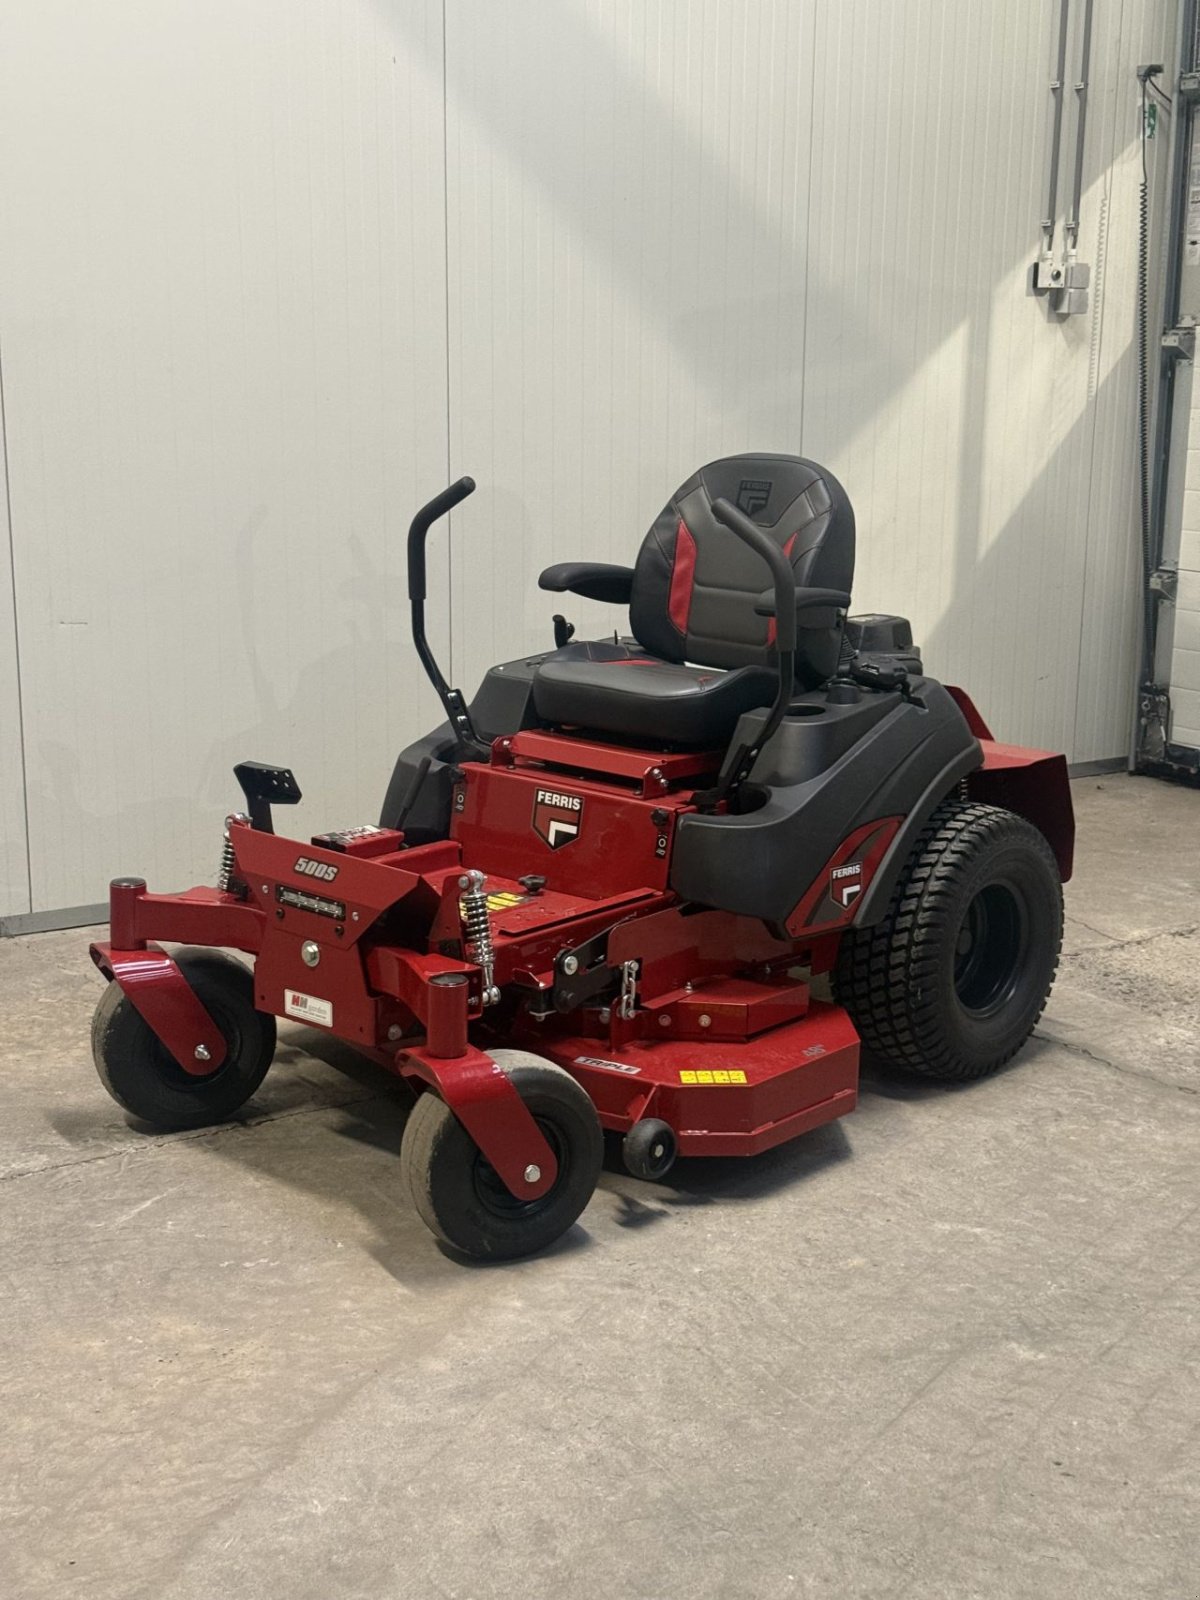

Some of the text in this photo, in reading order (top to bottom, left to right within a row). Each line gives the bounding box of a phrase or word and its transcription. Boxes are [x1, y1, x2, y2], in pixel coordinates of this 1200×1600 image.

[537, 790, 581, 811] FERRIS
[294, 857, 338, 881] 500S
[832, 864, 861, 879] FERRIS
[579, 1057, 635, 1073] TRIPLE
